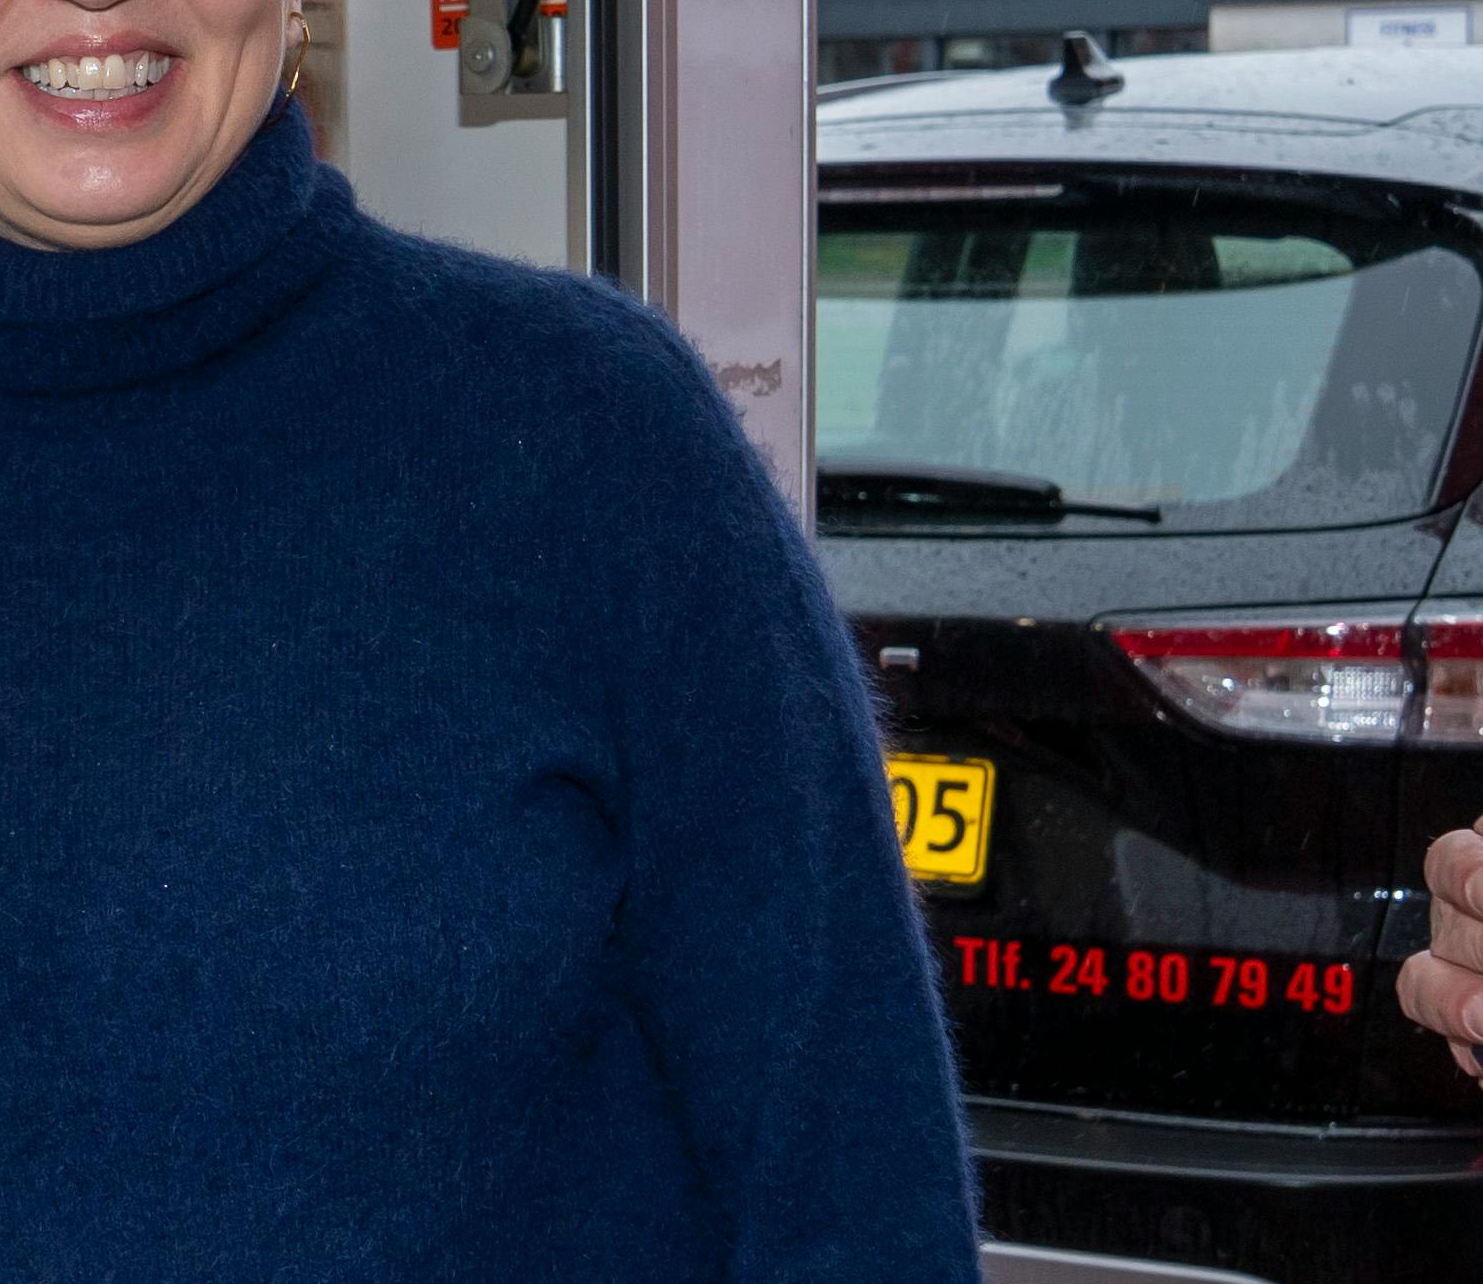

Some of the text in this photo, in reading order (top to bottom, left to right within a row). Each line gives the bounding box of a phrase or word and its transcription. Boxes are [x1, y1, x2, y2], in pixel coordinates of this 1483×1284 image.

[953, 936, 1354, 1016] Tlf. 24 80 79 49
